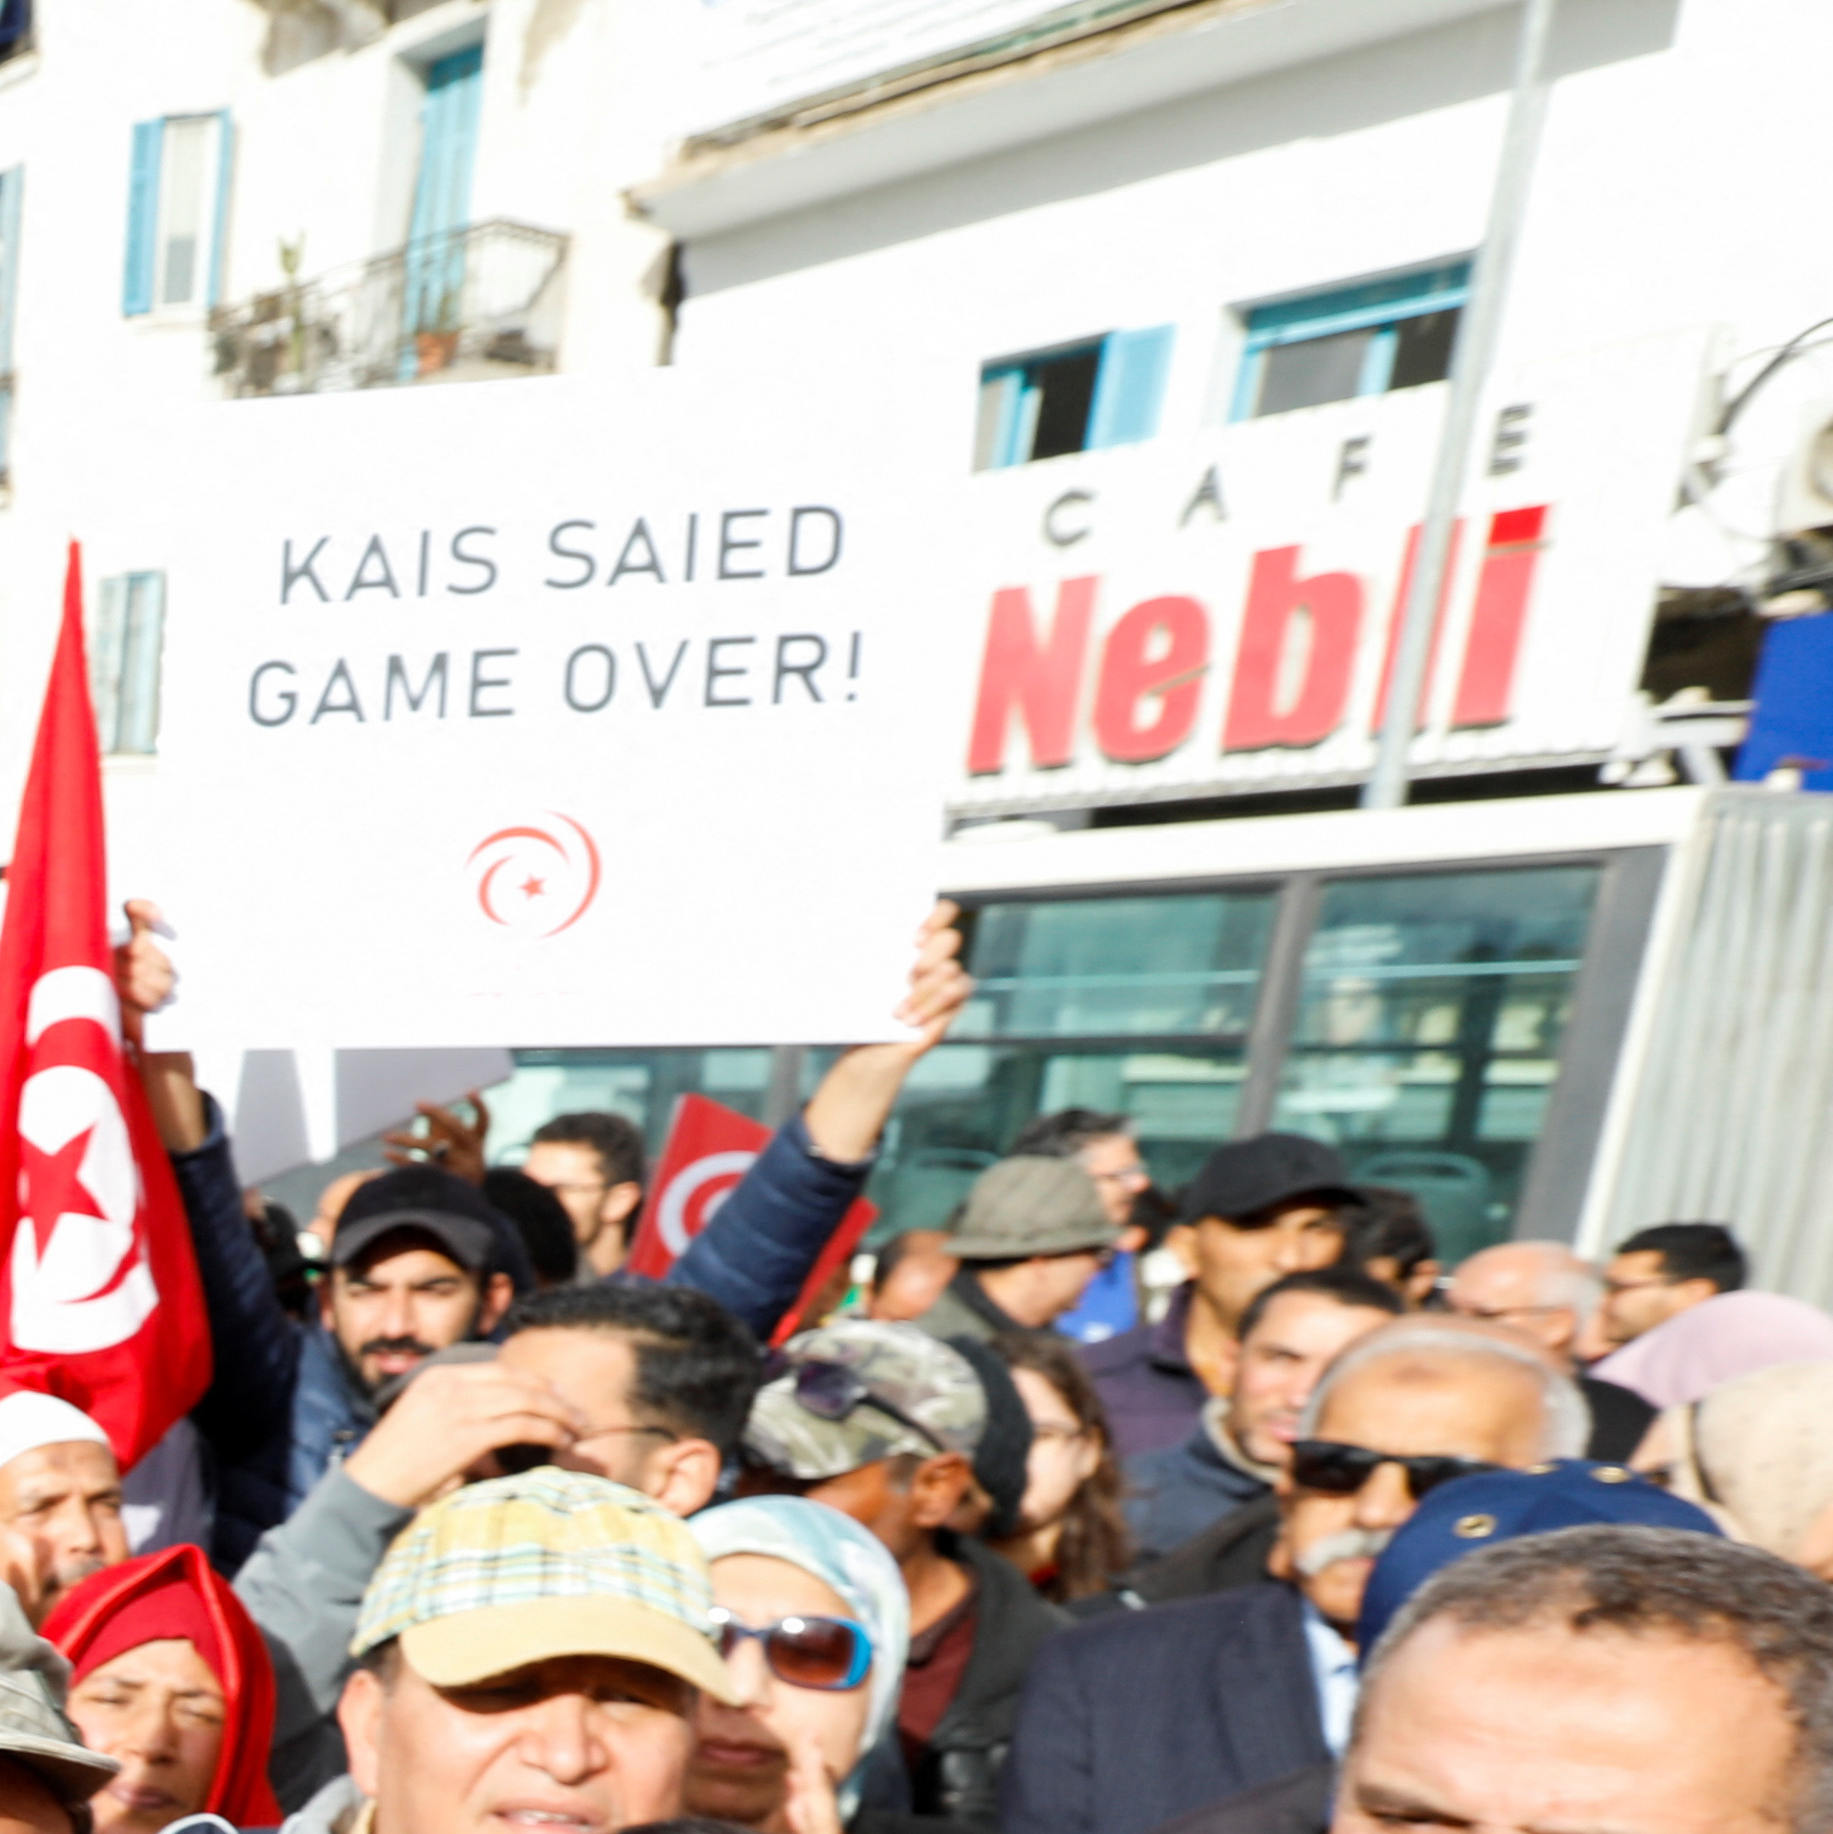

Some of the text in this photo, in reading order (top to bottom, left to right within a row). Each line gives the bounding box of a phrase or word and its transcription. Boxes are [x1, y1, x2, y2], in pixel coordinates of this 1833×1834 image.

[1044, 404, 1532, 546] CAFE
[279, 505, 846, 605] KAIS SAIED
[247, 631, 864, 728] GAME OVER!
[966, 503, 1552, 776] Nebli
